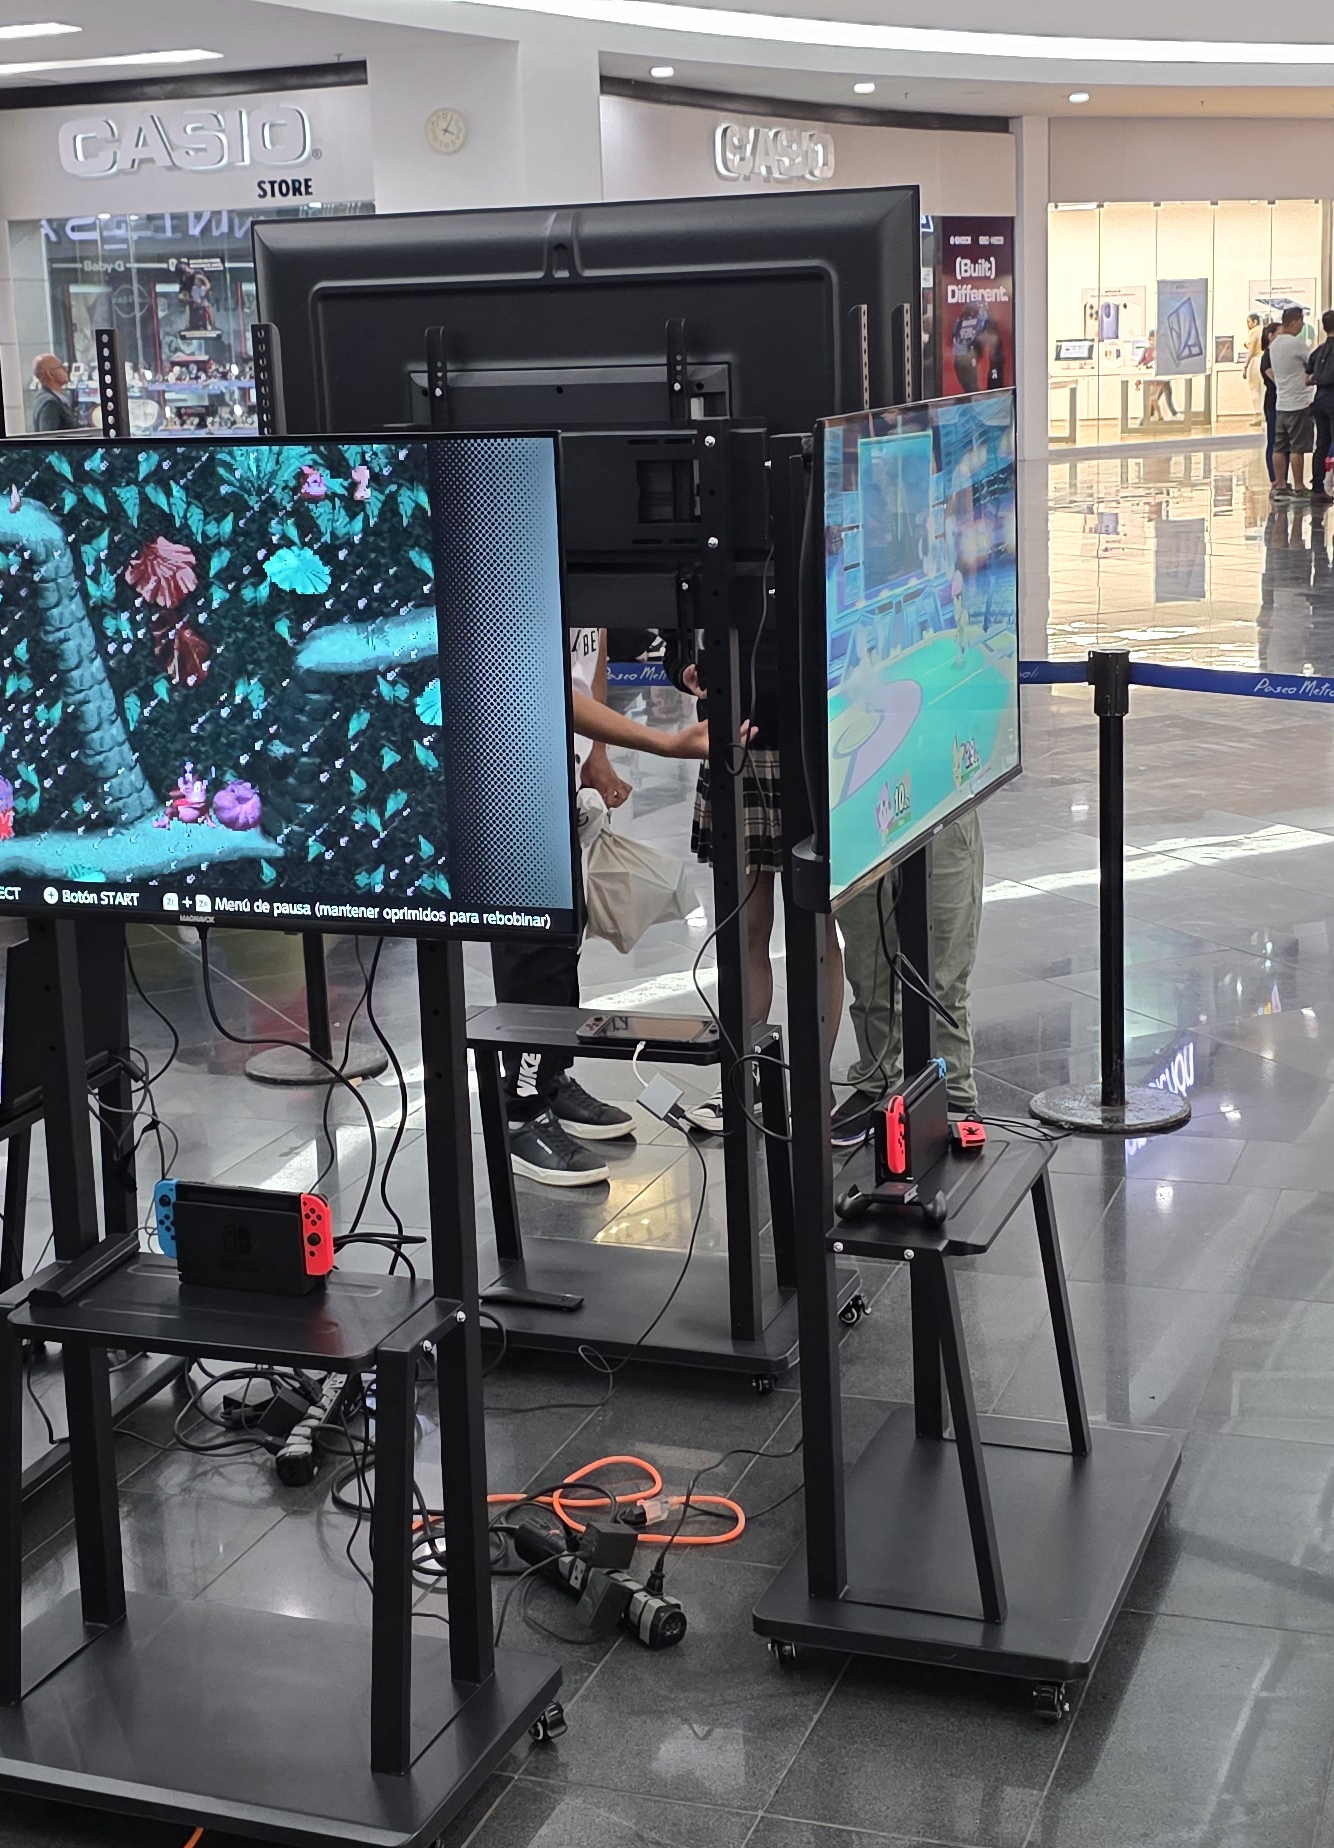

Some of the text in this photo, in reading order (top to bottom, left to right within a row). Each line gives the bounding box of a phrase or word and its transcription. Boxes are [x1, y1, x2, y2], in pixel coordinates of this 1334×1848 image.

[58, 105, 313, 178] CASIO
[714, 122, 836, 180] CASIO
[257, 178, 314, 199] STORE
[955, 256, 996, 280] (Built)
[947, 284, 1009, 303] Different.
[1253, 677, 1297, 695] Paseo
[62, 889, 140, 906] Botón START
[214, 896, 251, 912] Menú
[254, 898, 271, 913] de
[273, 901, 311, 917] pausa
[315, 903, 379, 920] (mantener
[383, 906, 447, 924] oprimidos
[450, 911, 480, 926] para
[483, 911, 551, 930] rebobinar)
